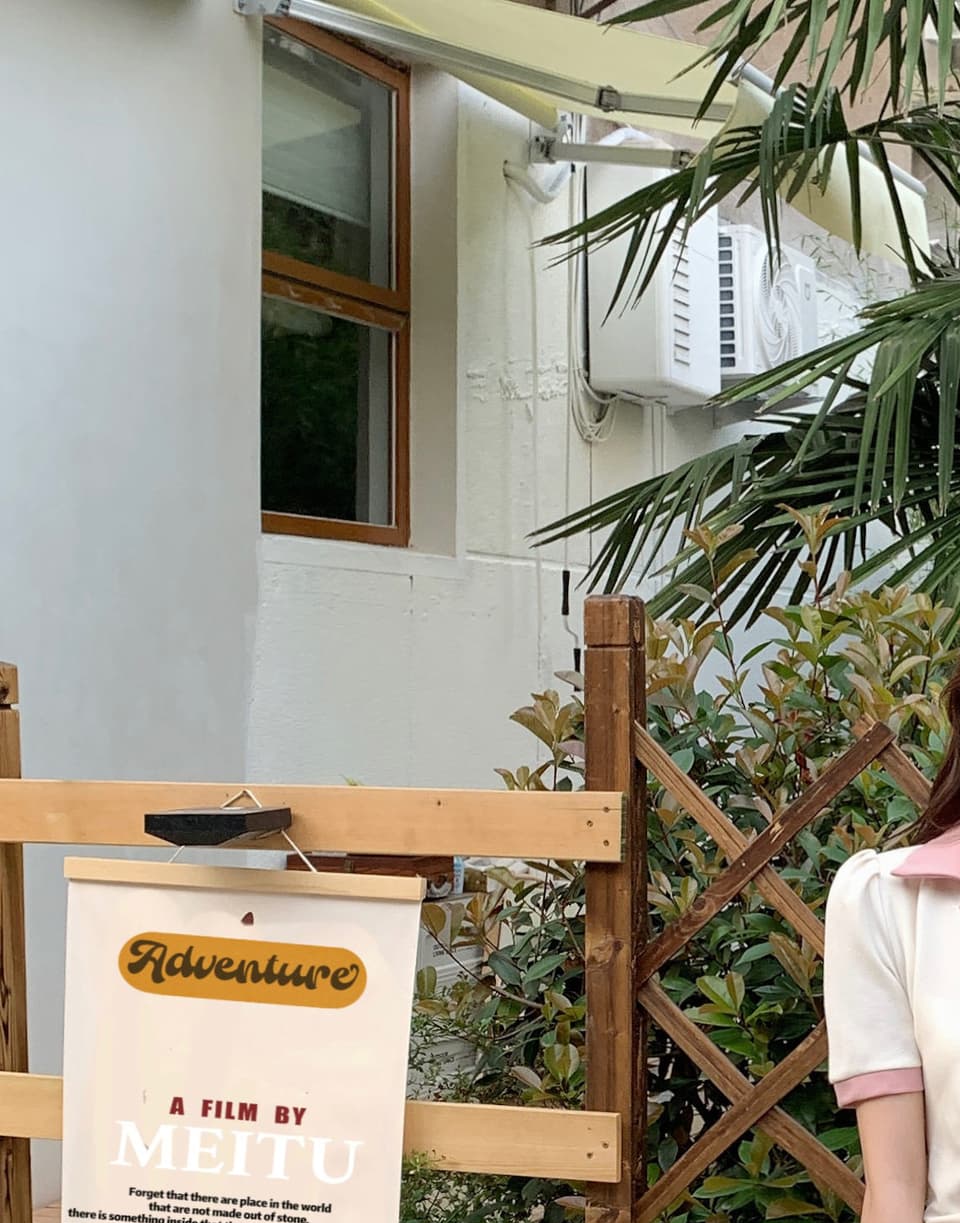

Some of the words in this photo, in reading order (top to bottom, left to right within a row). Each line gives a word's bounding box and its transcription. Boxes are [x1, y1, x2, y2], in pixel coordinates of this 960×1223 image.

[127, 939, 360, 991] Adventure
[169, 1096, 185, 1116] A
[201, 1099, 258, 1122] FILM
[274, 1105, 307, 1126] BY
[109, 1119, 365, 1185] MEITU
[68, 1207, 97, 1220] there
[98, 1209, 107, 1220] is
[128, 1187, 164, 1200] Forget
[166, 1189, 189, 1201] that
[190, 1191, 219, 1204] there
[220, 1195, 238, 1206] are
[239, 1196, 268, 1208] place
[269, 1198, 280, 1209] in
[281, 1199, 299, 1211] the
[301, 1203, 332, 1214] world
[148, 1202, 171, 1213] that
[172, 1206, 191, 1215] are
[191, 1206, 211, 1216] not
[212, 1208, 242, 1219] made
[243, 1211, 262, 1221] out
[263, 1211, 275, 1222] of
